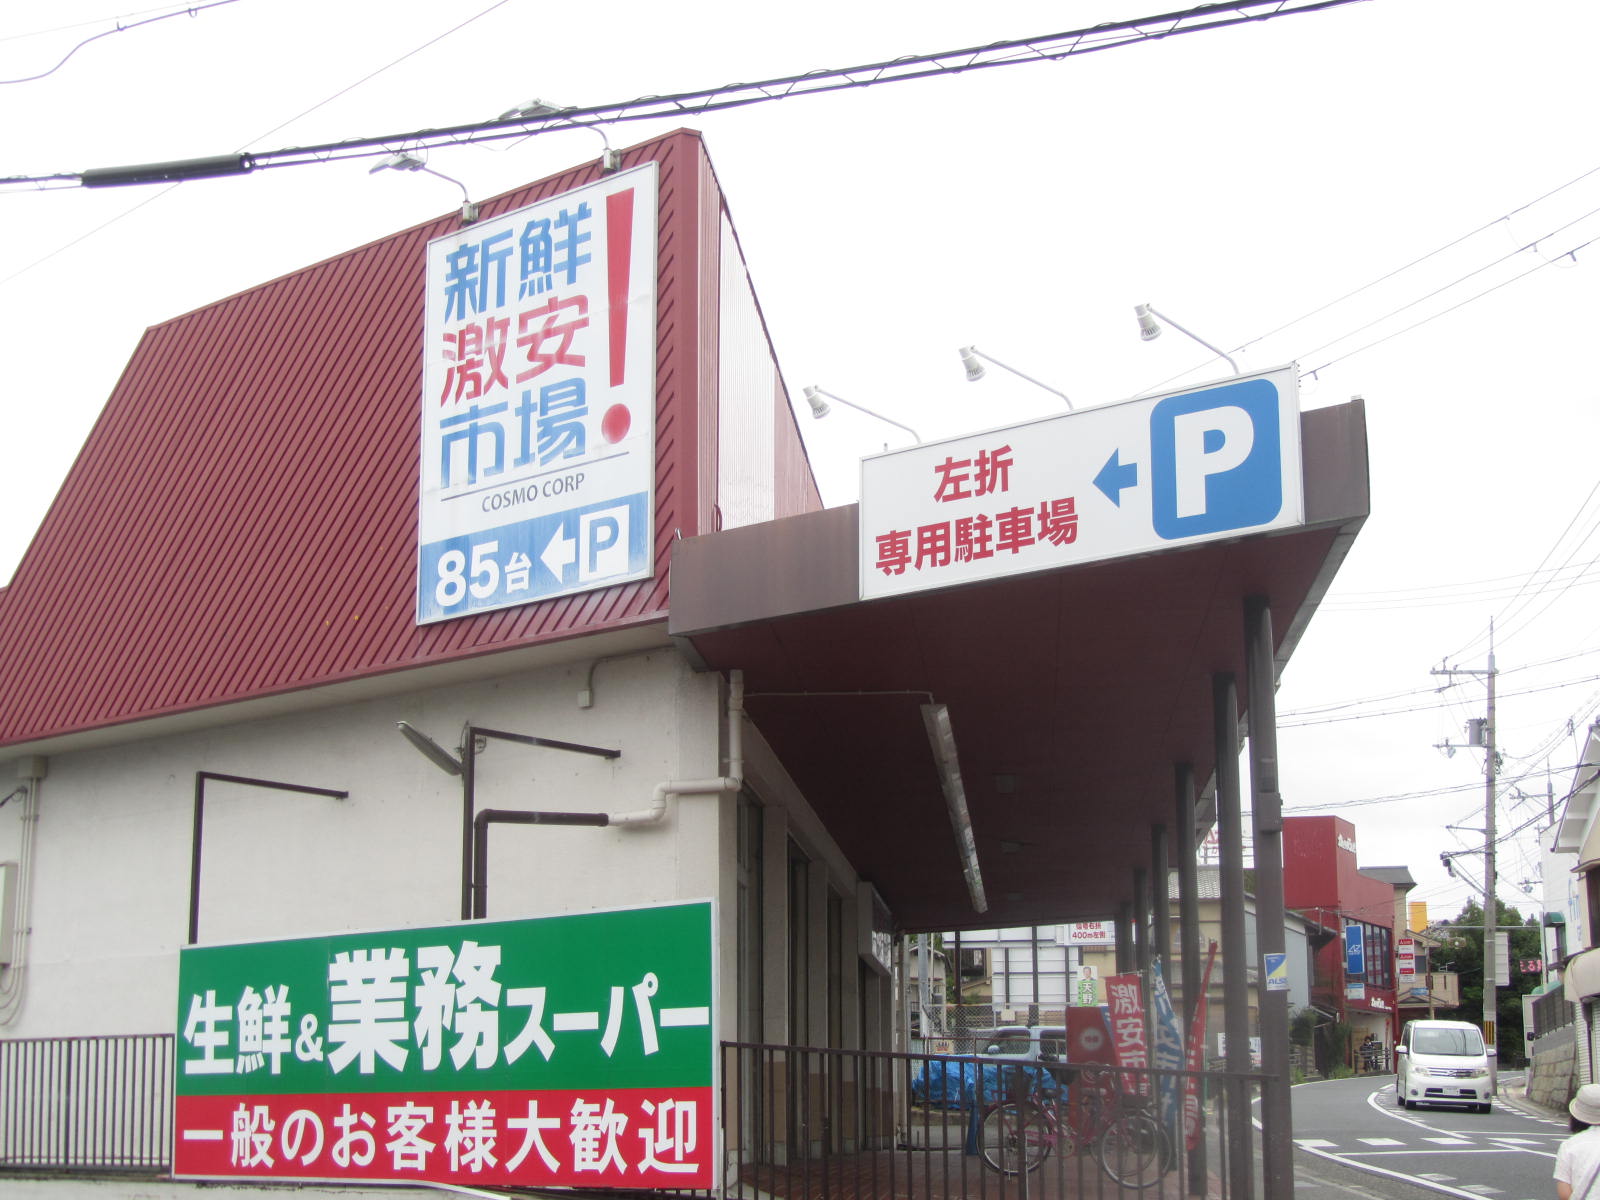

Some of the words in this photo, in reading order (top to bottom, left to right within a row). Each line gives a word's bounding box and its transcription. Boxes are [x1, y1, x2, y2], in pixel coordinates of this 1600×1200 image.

[444, 201, 592, 324] 新鮮
[441, 295, 590, 407] 激安
[439, 377, 589, 490] 市場
[934, 444, 1014, 503] 左折
[1174, 405, 1254, 519] P
[482, 480, 539, 512] COSMO
[542, 472, 585, 497] CORP
[875, 496, 1079, 576] 専用駐車場
[435, 540, 532, 607] 85台
[588, 516, 620, 573] P
[183, 940, 710, 1075] 生鮮&業務スーパー
[1081, 982, 1094, 1005] 天野
[182, 1097, 699, 1174] 一般のお客様大歓迎
